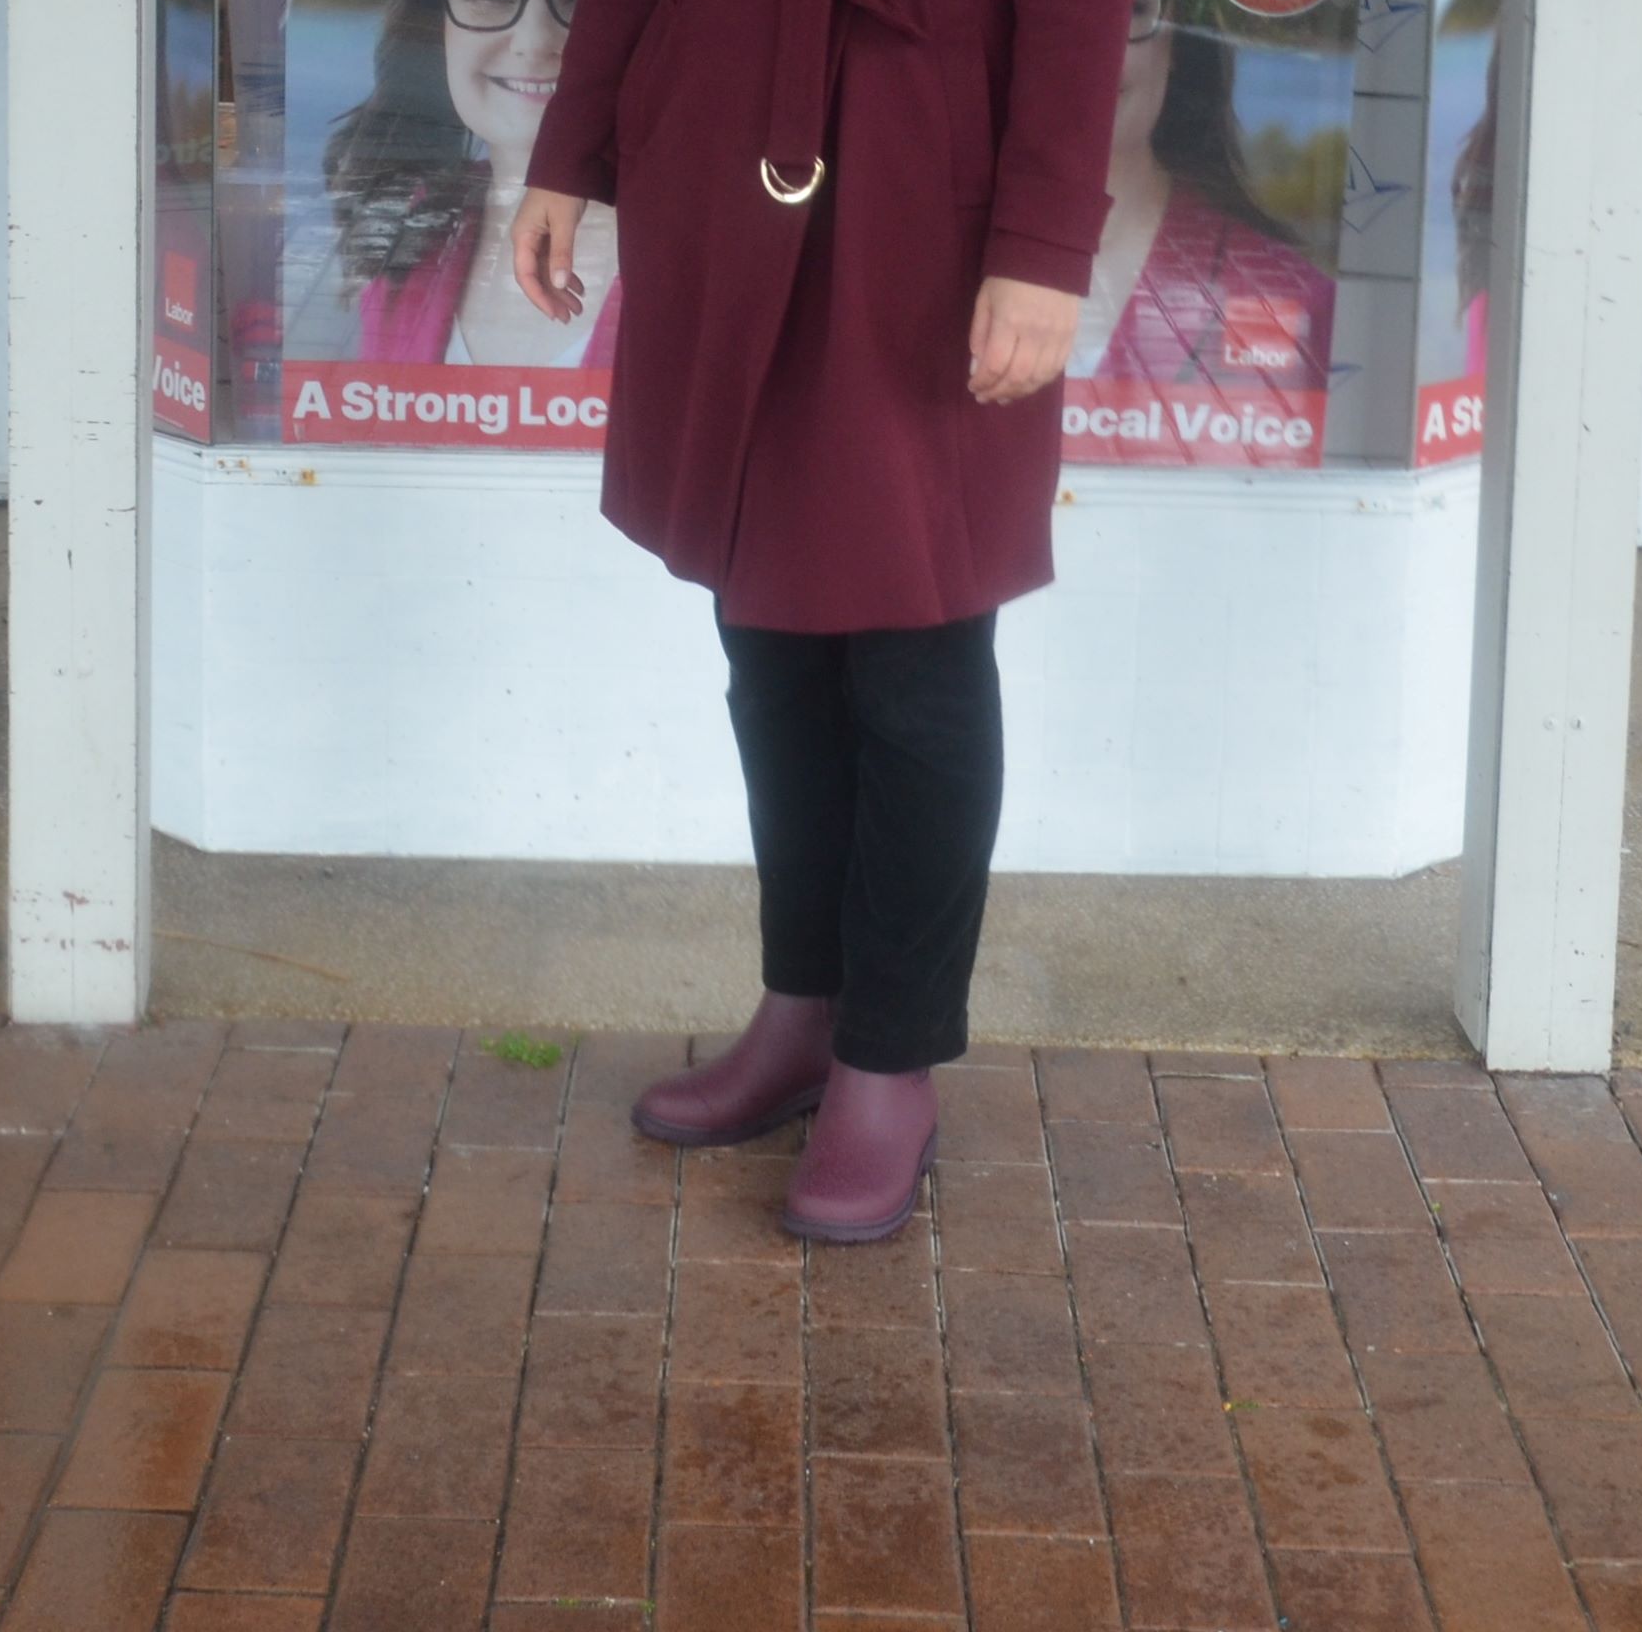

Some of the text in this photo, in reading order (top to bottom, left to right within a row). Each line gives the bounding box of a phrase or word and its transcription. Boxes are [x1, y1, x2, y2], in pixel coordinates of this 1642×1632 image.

[165, 297, 193, 327] Labor
[1225, 344, 1292, 368] Labor
[293, 381, 331, 419] A
[341, 382, 509, 434] Strong
[1171, 403, 1314, 448] Voice
[1423, 403, 1447, 443] A
